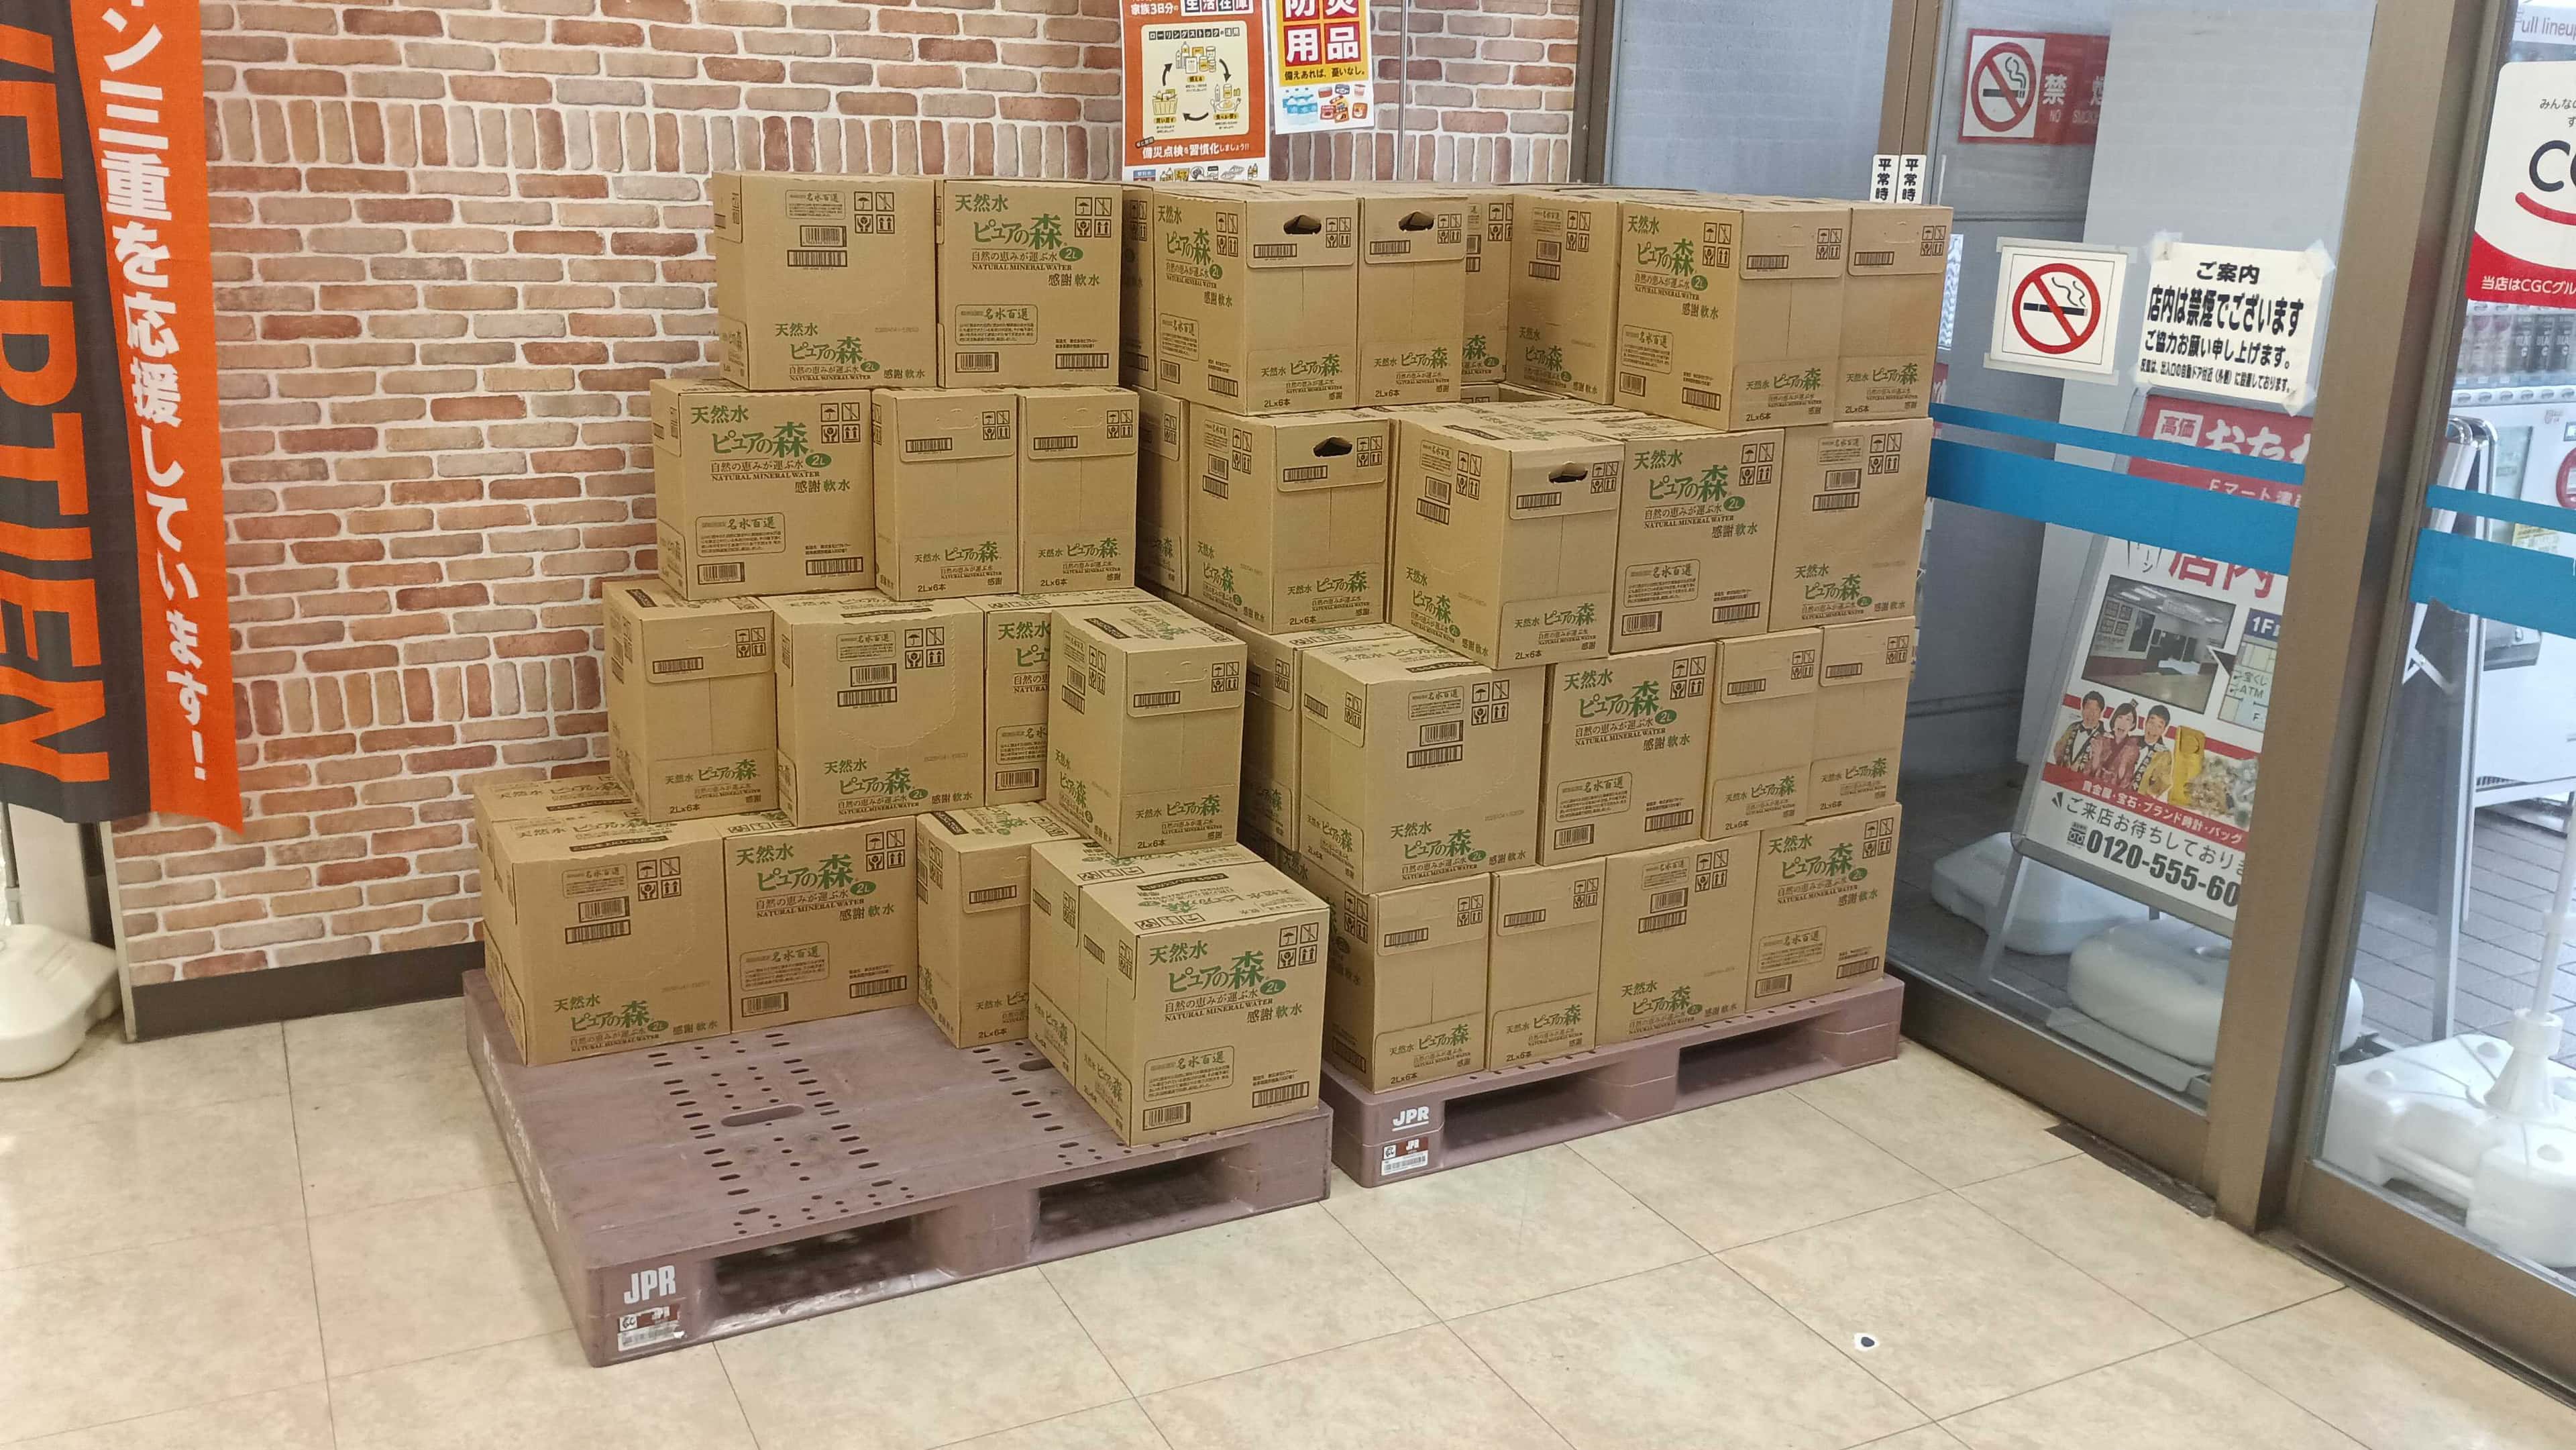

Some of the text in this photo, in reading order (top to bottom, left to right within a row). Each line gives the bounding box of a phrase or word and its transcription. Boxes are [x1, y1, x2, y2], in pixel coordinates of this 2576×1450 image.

[1287, 26, 1358, 63] 用品
[1285, 66, 1365, 81] 備えあれば、憂いなし。
[1876, 158, 1892, 201] 平常時
[1902, 158, 1919, 201] 平常時
[955, 194, 1008, 212] 天然水
[1158, 205, 1182, 225] 天然水
[1627, 215, 1660, 234] 天然水
[974, 213, 1063, 250] ピュアの森
[1638, 238, 1695, 276] ピュアの森
[2196, 261, 2260, 284] ご案内
[2147, 284, 2304, 337] 店内は禁煙でございます
[775, 323, 818, 336] 天然水
[2145, 329, 2290, 369] ご協力お願い申し上げます。
[99, 0, 208, 781] ン三重を応援しています!
[691, 405, 749, 424] 天然水
[2161, 415, 2197, 437] 高価
[712, 421, 809, 458] ピュアの森
[1633, 449, 1684, 470] 天然水
[1649, 464, 1728, 503] ピュアの森
[1406, 567, 1427, 586] 天然水
[1794, 564, 1829, 579] 天然水
[1563, 668, 1613, 691] 天然水
[1579, 680, 1659, 718] ピュアの森
[2240, 685, 2264, 699] ATM
[824, 758, 867, 774] 天然水
[1390, 821, 1432, 839] 天然水
[736, 843, 794, 866] 天然水
[1768, 833, 1813, 856] 天然水
[757, 853, 853, 892] ピュアの森
[1782, 842, 1853, 880] ピュアの森
[1148, 941, 1208, 966] 天然水
[1169, 951, 1265, 993] ピュアの森
[1621, 981, 1657, 997] 天然水
[554, 993, 600, 1013] 天然水
[1393, 1106, 1430, 1127] JPR
[623, 1265, 676, 1304] JPR
